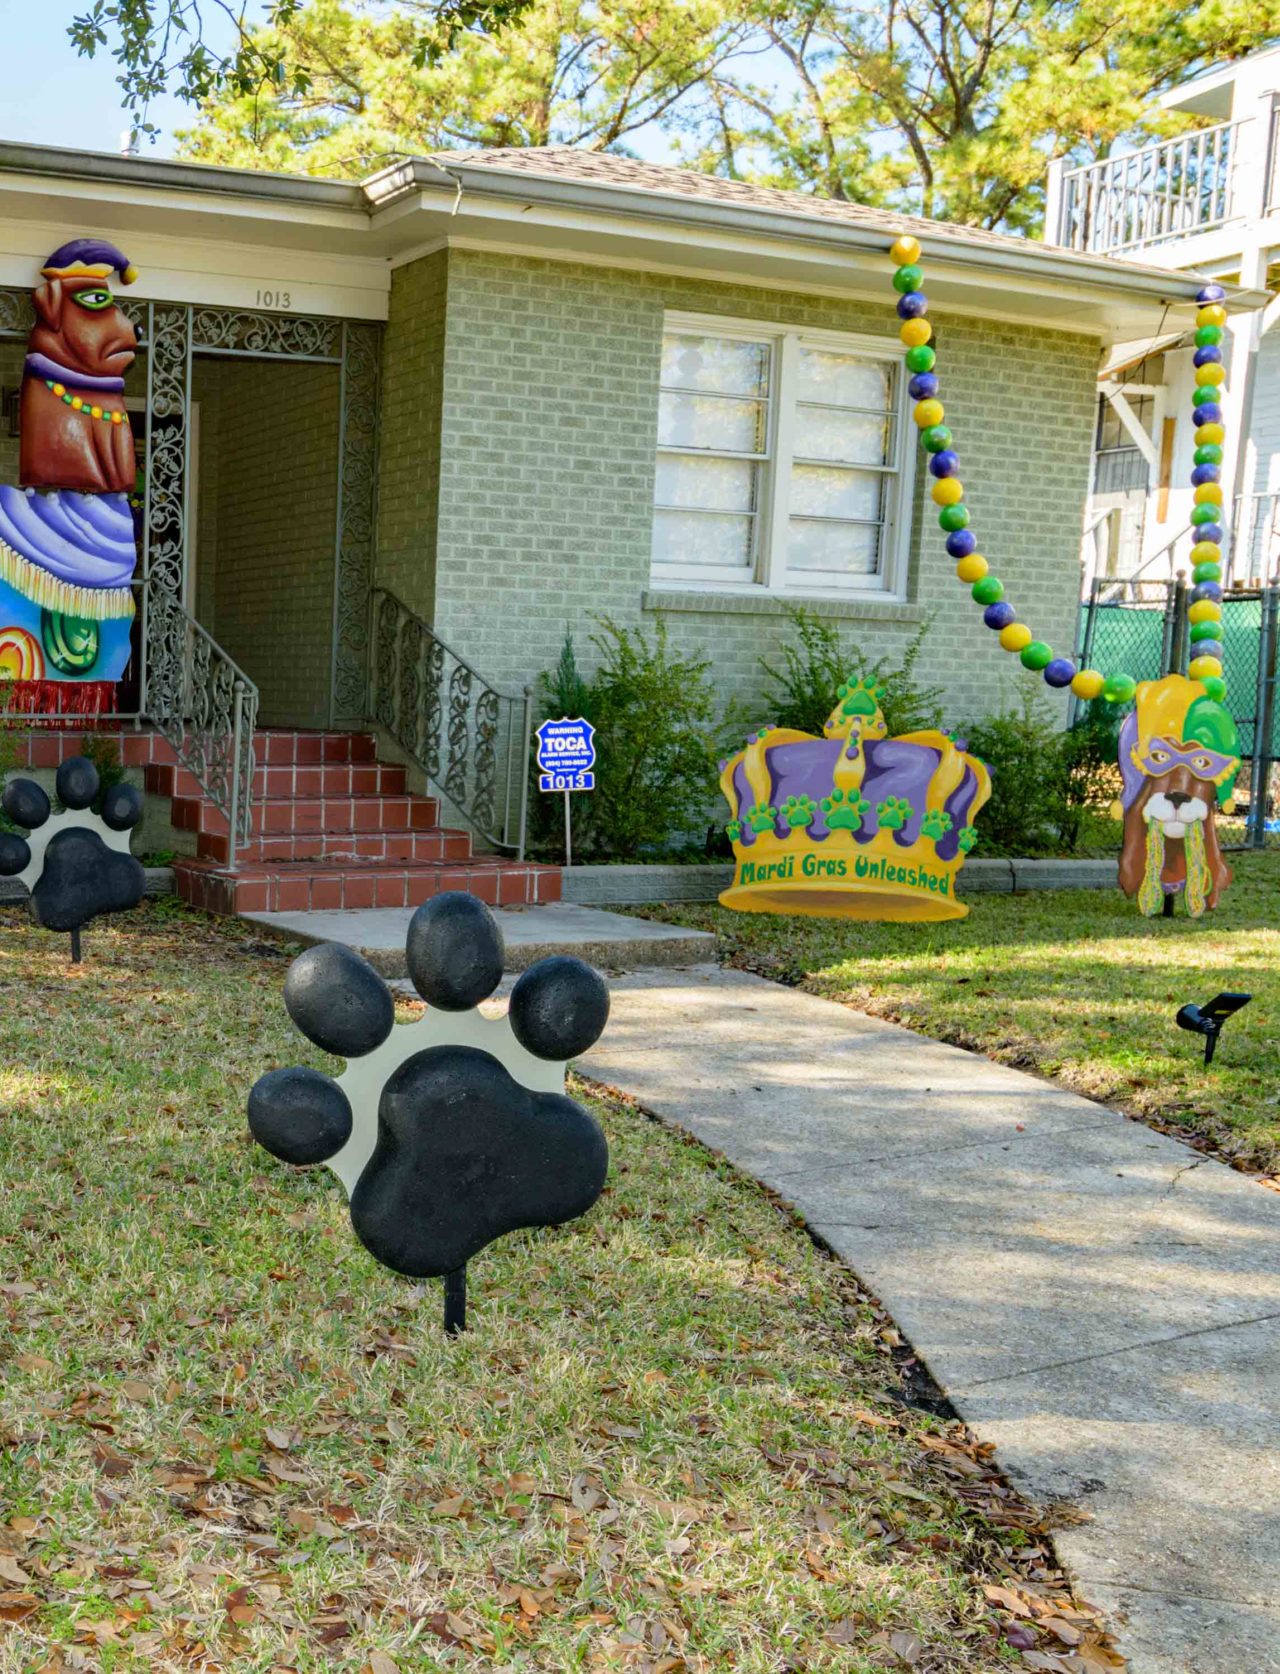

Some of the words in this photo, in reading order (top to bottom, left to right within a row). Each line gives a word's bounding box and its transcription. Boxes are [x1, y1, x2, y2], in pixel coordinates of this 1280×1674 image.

[256, 290, 291, 308] 1013
[547, 727, 583, 735] WARNING
[544, 737, 587, 751] TOCA
[546, 775, 585, 788] 1013
[740, 855, 795, 885] Mardi
[802, 854, 847, 877] Gras
[855, 855, 950, 896] Unleashed
